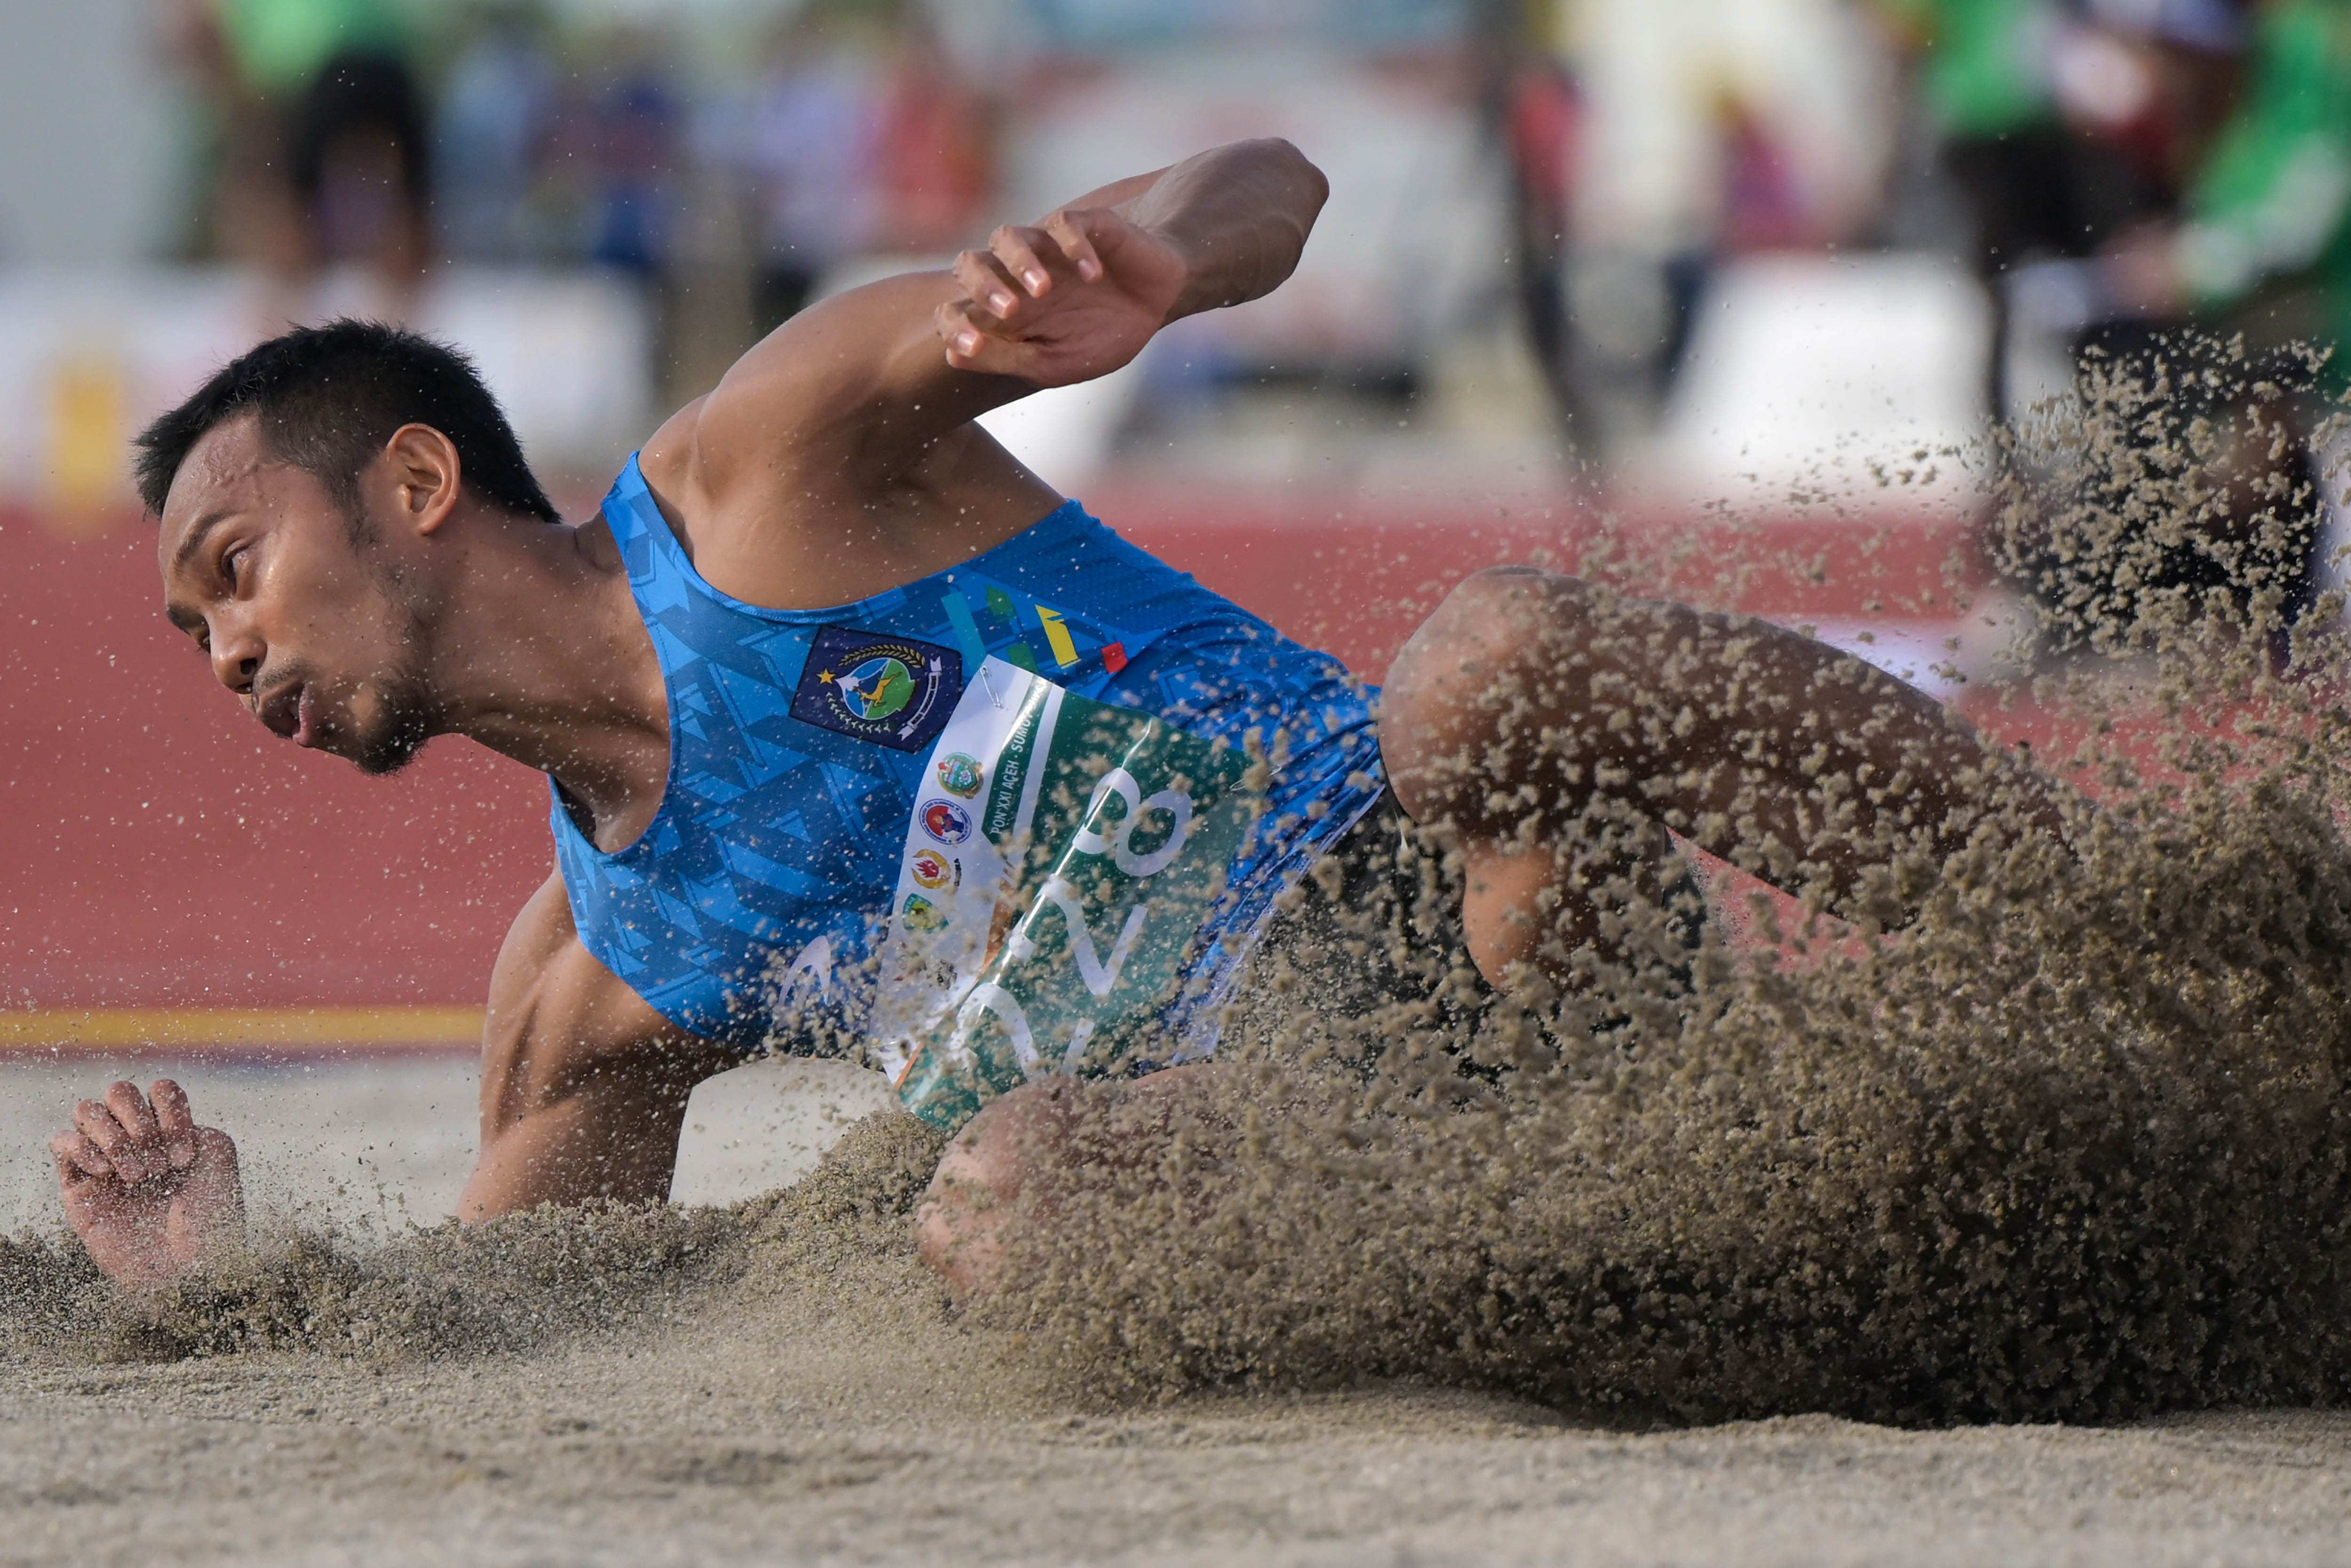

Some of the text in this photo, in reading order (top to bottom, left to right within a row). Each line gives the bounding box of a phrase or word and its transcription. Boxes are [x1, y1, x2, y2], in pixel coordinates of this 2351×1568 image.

[1002, 760, 1019, 789] ACEH
[996, 791, 1012, 809] XXI
[990, 811, 1007, 834] PON
[949, 768, 1193, 1082] 228
